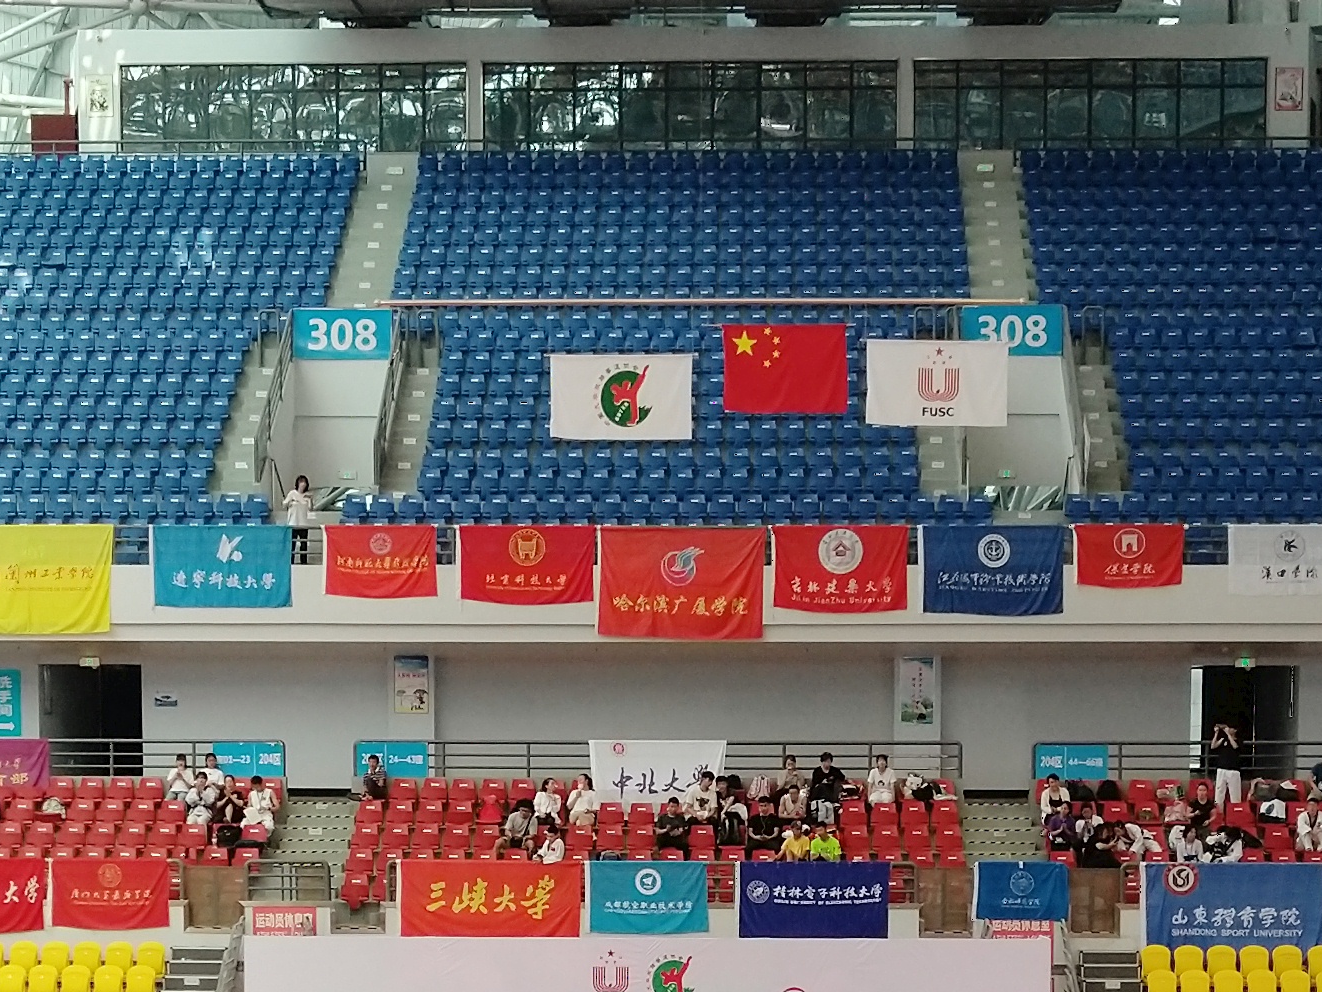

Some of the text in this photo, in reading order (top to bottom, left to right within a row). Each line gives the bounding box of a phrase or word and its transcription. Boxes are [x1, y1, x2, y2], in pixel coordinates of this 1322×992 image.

[308, 319, 377, 350] 308
[977, 315, 1047, 347] 308
[922, 406, 954, 417] FUSC
[814, 596, 845, 606] JianZhu
[849, 596, 891, 606] University
[1171, 929, 1303, 938] SHANDONG SPORT UNIVERSITY
